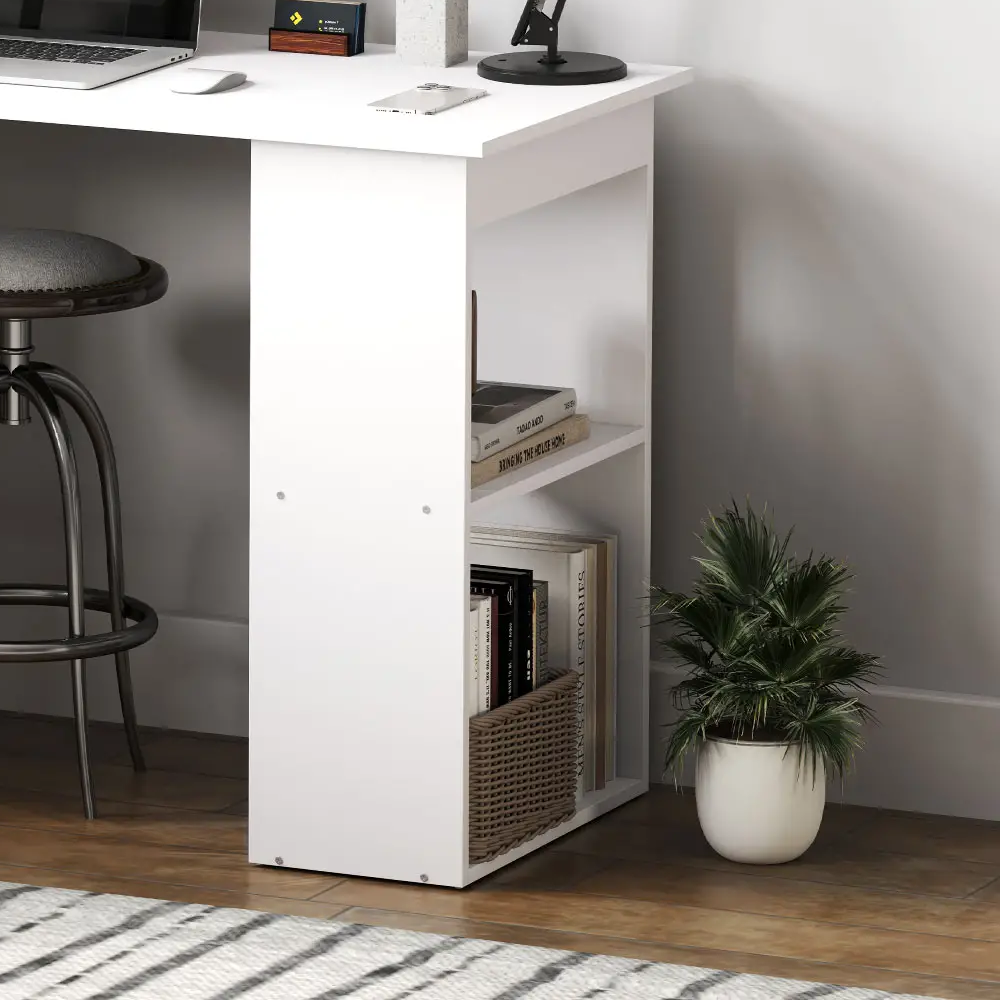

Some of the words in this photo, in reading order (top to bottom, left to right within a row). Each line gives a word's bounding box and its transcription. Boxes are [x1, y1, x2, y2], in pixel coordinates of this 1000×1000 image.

[516, 421, 532, 435] TADAO
[531, 414, 544, 427] ANDO
[499, 452, 522, 473] BRINGING
[523, 446, 533, 461] THE
[534, 439, 551, 457] HOUSE
[551, 433, 565, 450] HOME
[577, 570, 585, 651] STORIES
